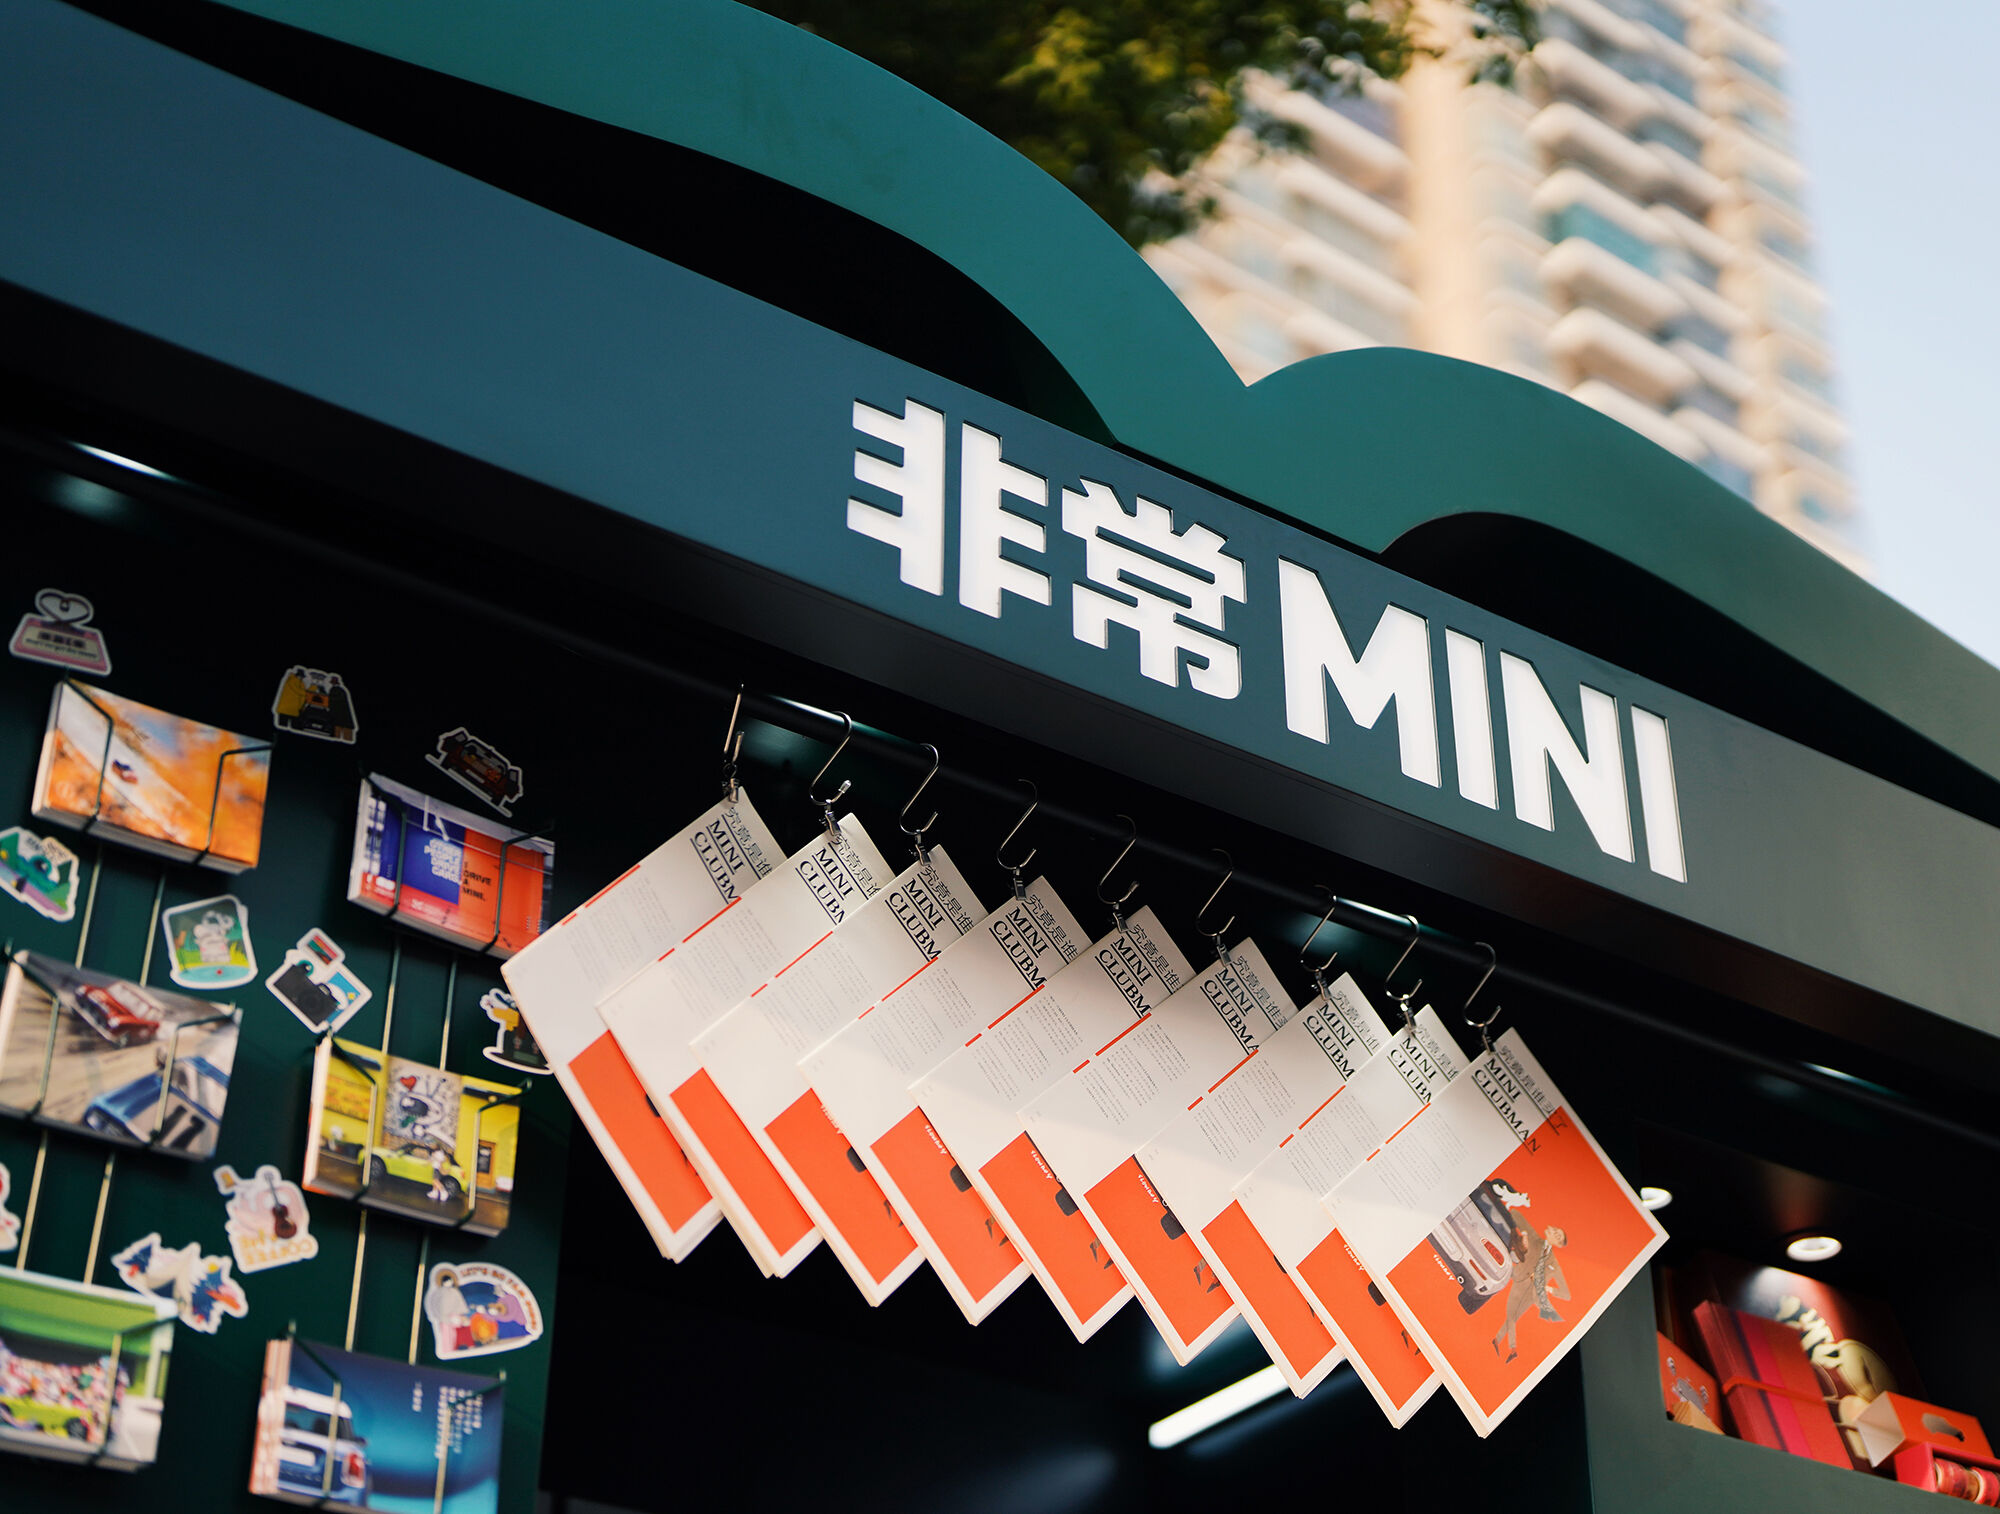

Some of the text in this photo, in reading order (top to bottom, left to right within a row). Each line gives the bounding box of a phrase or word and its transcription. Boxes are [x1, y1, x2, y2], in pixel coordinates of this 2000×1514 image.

[846, 398, 1688, 884] 非常 MINI
[709, 819, 746, 872] MINI
[815, 847, 855, 898] MINI
[889, 892, 942, 960] CLUBM
[903, 877, 946, 929] MINI
[1024, 894, 1079, 960] 究竟是谁
[993, 920, 1048, 988] CLUBM
[1007, 906, 1050, 956] MINI
[1098, 949, 1152, 1017] CLUBM
[1112, 935, 1154, 985] MINI
[1217, 967, 1256, 1015] MINI
[1306, 1015, 1356, 1078] CLUBM
[1319, 1002, 1356, 1047] MINI
[1402, 1036, 1437, 1079] MINI
[1486, 1057, 1522, 1101] MINI
[1474, 1068, 1542, 1153] CLUBMAN
